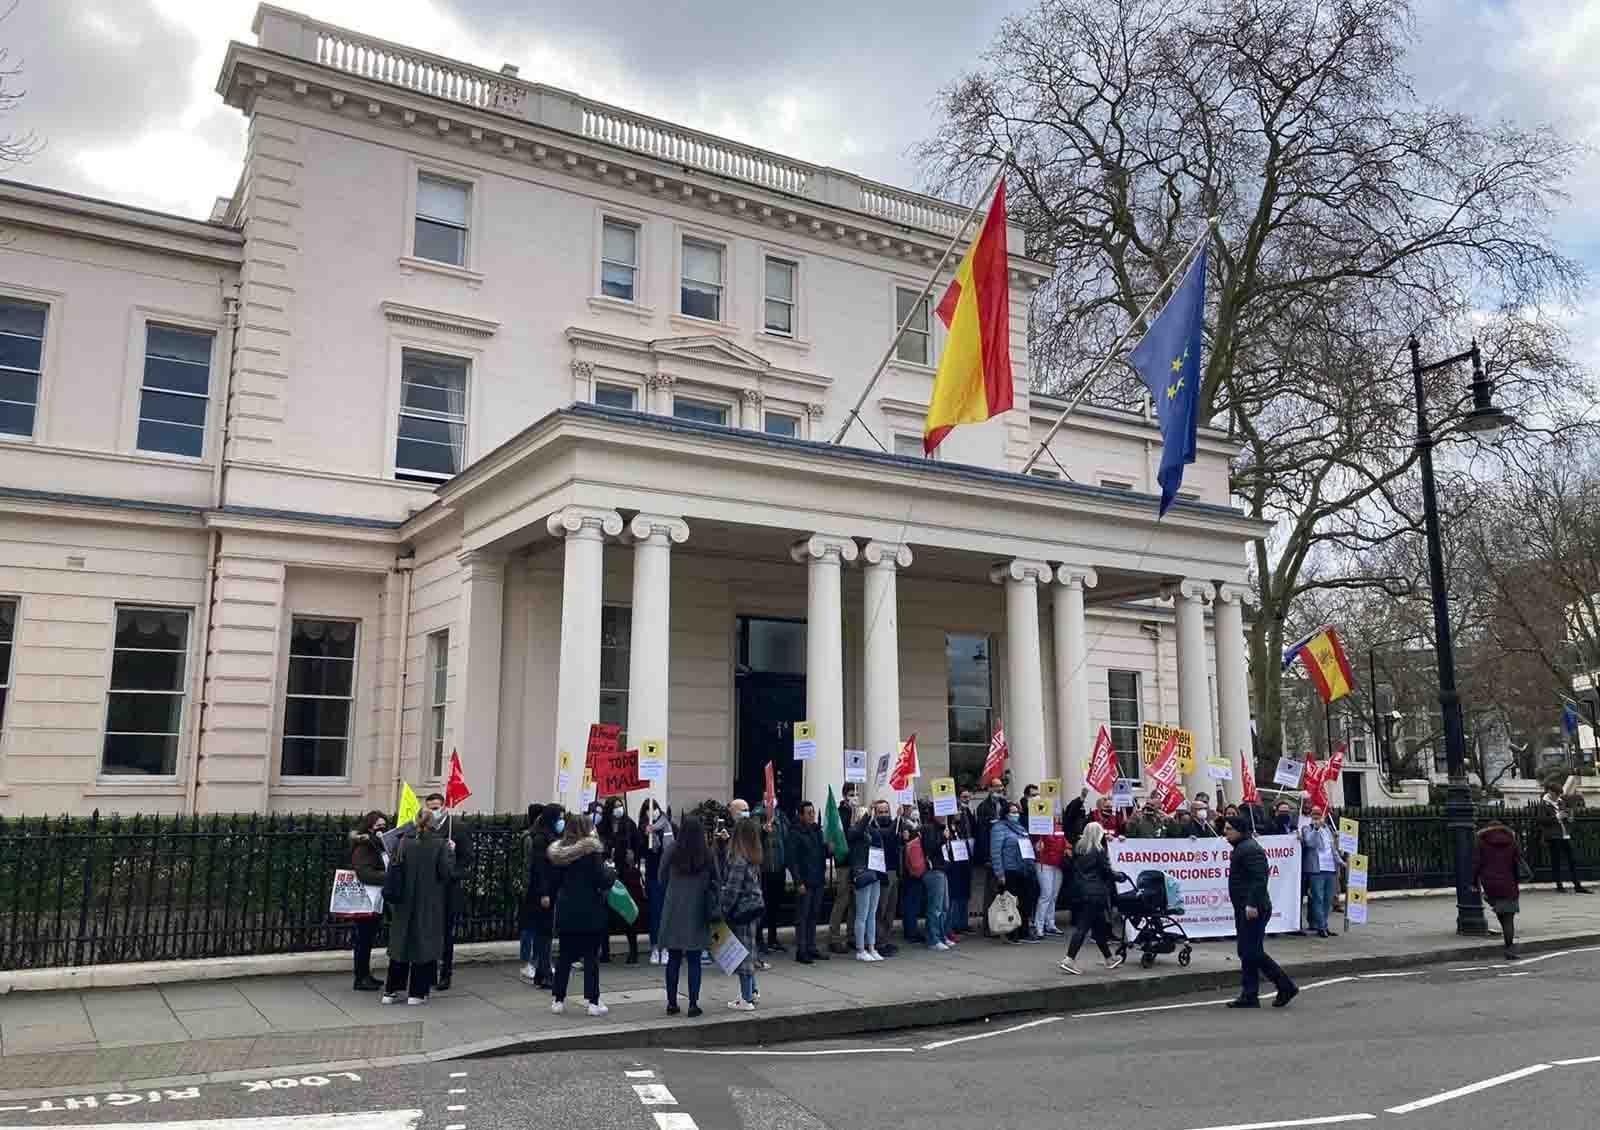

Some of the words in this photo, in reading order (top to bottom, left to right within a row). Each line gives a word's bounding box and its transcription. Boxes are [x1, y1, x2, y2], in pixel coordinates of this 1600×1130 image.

[1212, 851, 1218, 861] Y
[241, 1072, 360, 1092] LOOK
[27, 1088, 201, 1113] RIGHT
